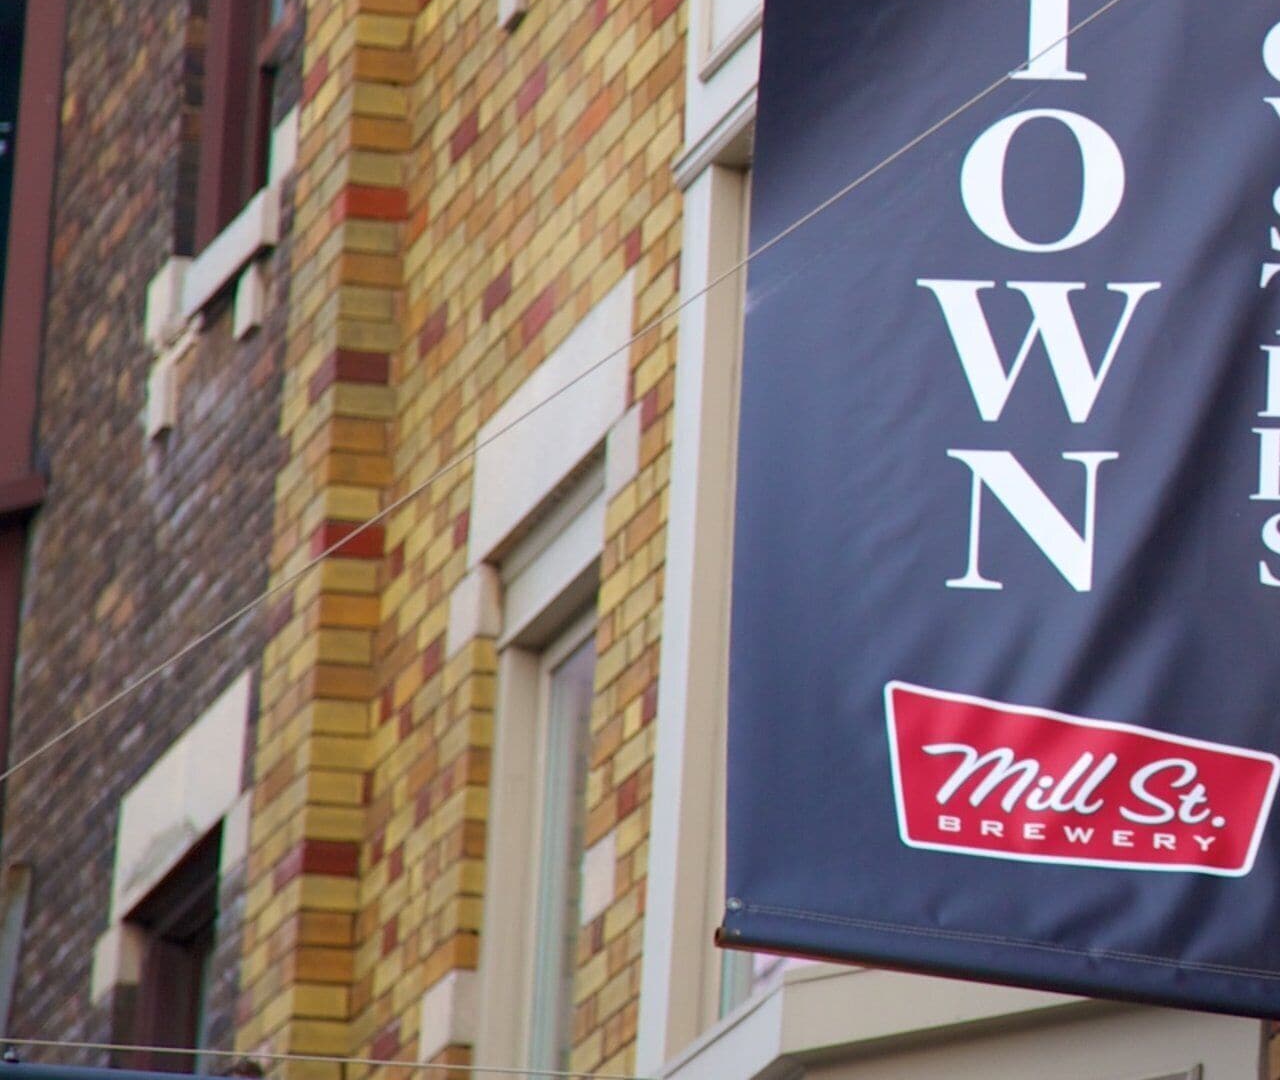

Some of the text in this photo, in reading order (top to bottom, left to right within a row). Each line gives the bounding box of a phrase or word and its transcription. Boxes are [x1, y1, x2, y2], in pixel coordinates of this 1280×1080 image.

[921, 743, 1226, 828] Mill St.
[937, 814, 1217, 852] BREWERY
